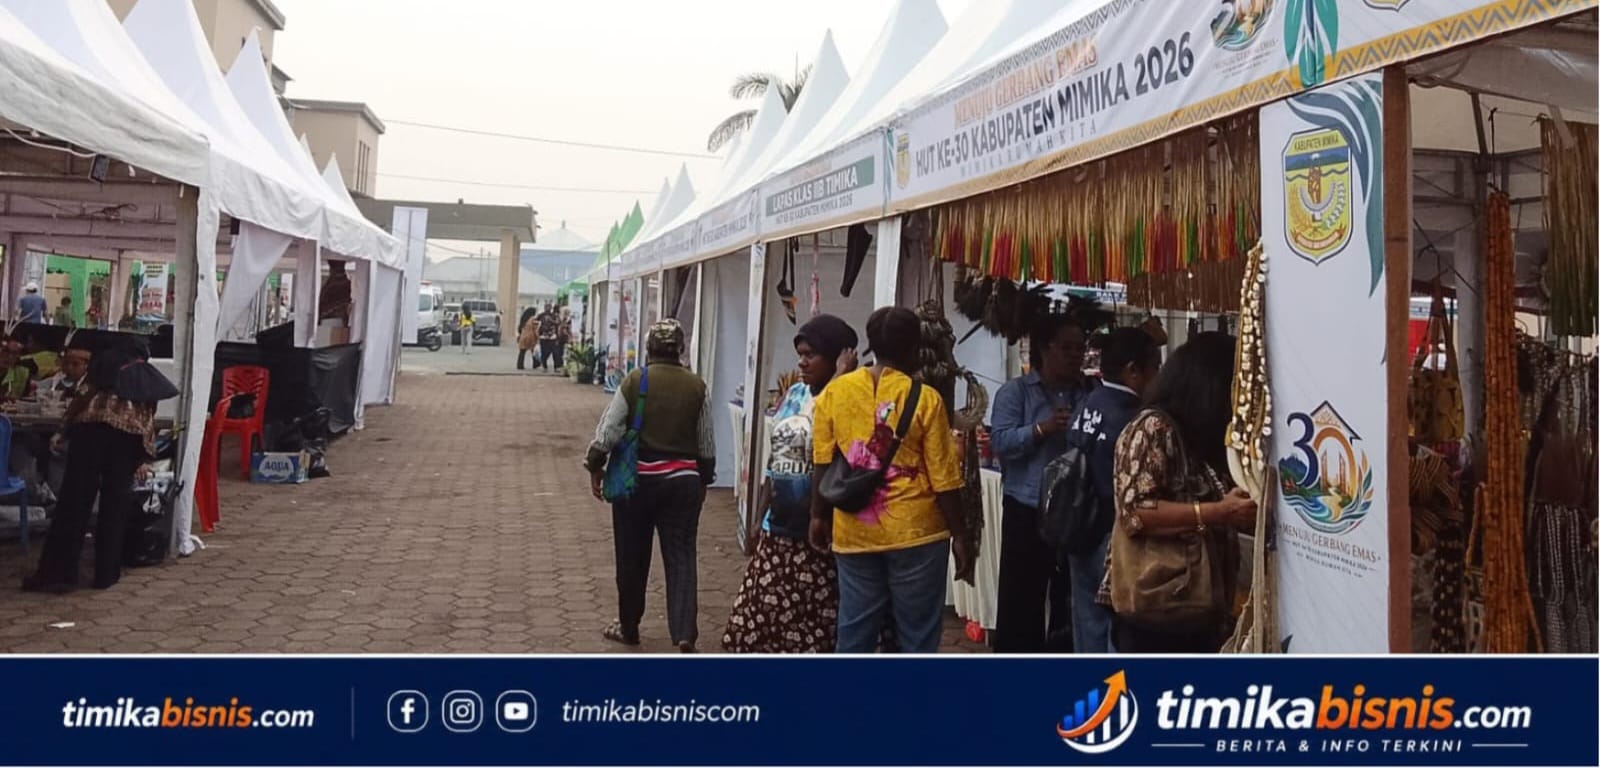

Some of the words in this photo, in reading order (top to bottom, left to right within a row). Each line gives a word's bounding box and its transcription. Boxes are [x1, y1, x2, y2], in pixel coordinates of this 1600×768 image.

[915, 143, 935, 178] HUT
[936, 131, 969, 171] KE-30
[971, 94, 1056, 159] KABUPATEN
[1057, 62, 1130, 126] MIMIKA
[1134, 31, 1194, 97] 2026
[793, 181, 813, 206] KLAS
[825, 165, 859, 197] TIMIKA
[1312, 532, 1351, 556] GERBANG
[1352, 544, 1377, 564] EMAS
